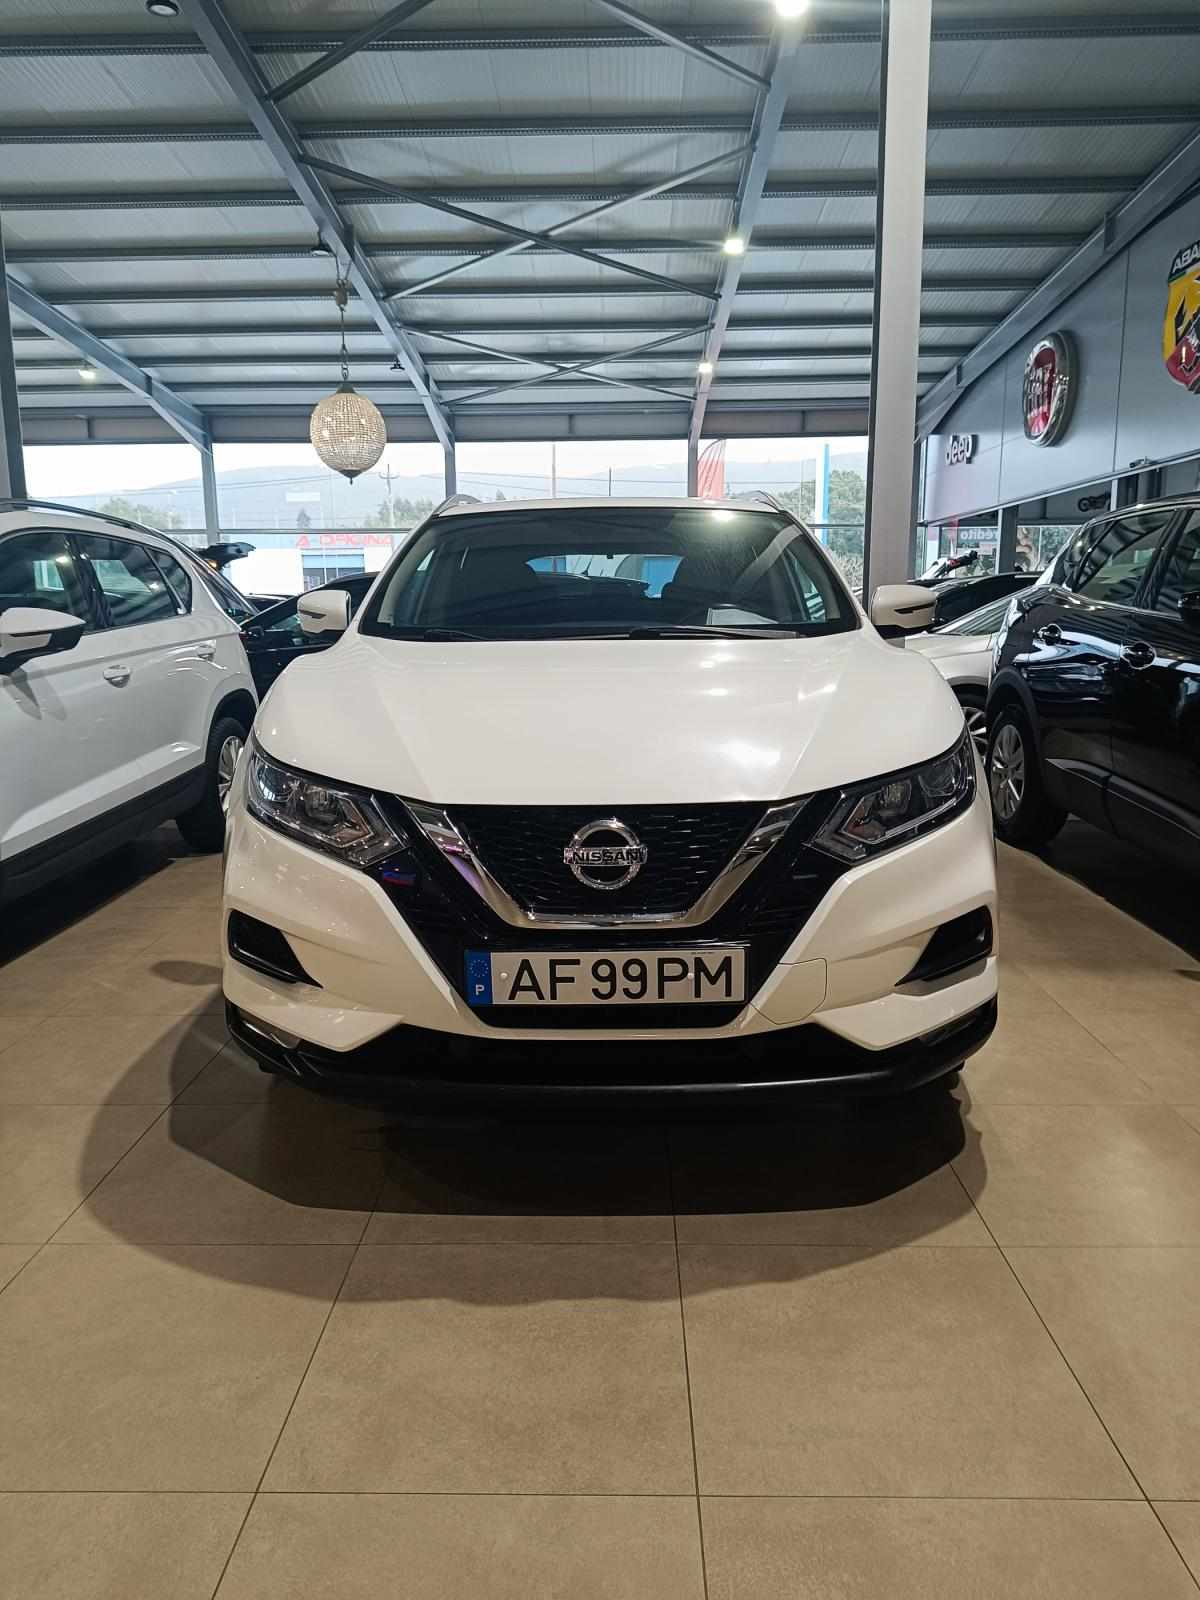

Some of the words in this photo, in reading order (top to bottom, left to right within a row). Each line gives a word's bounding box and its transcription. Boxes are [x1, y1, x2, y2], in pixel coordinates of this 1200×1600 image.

[572, 849, 639, 862] NISSAN
[508, 958, 581, 1001] AF
[591, 958, 648, 1001] 99
[657, 955, 732, 1000] PM
[475, 984, 485, 996] P
